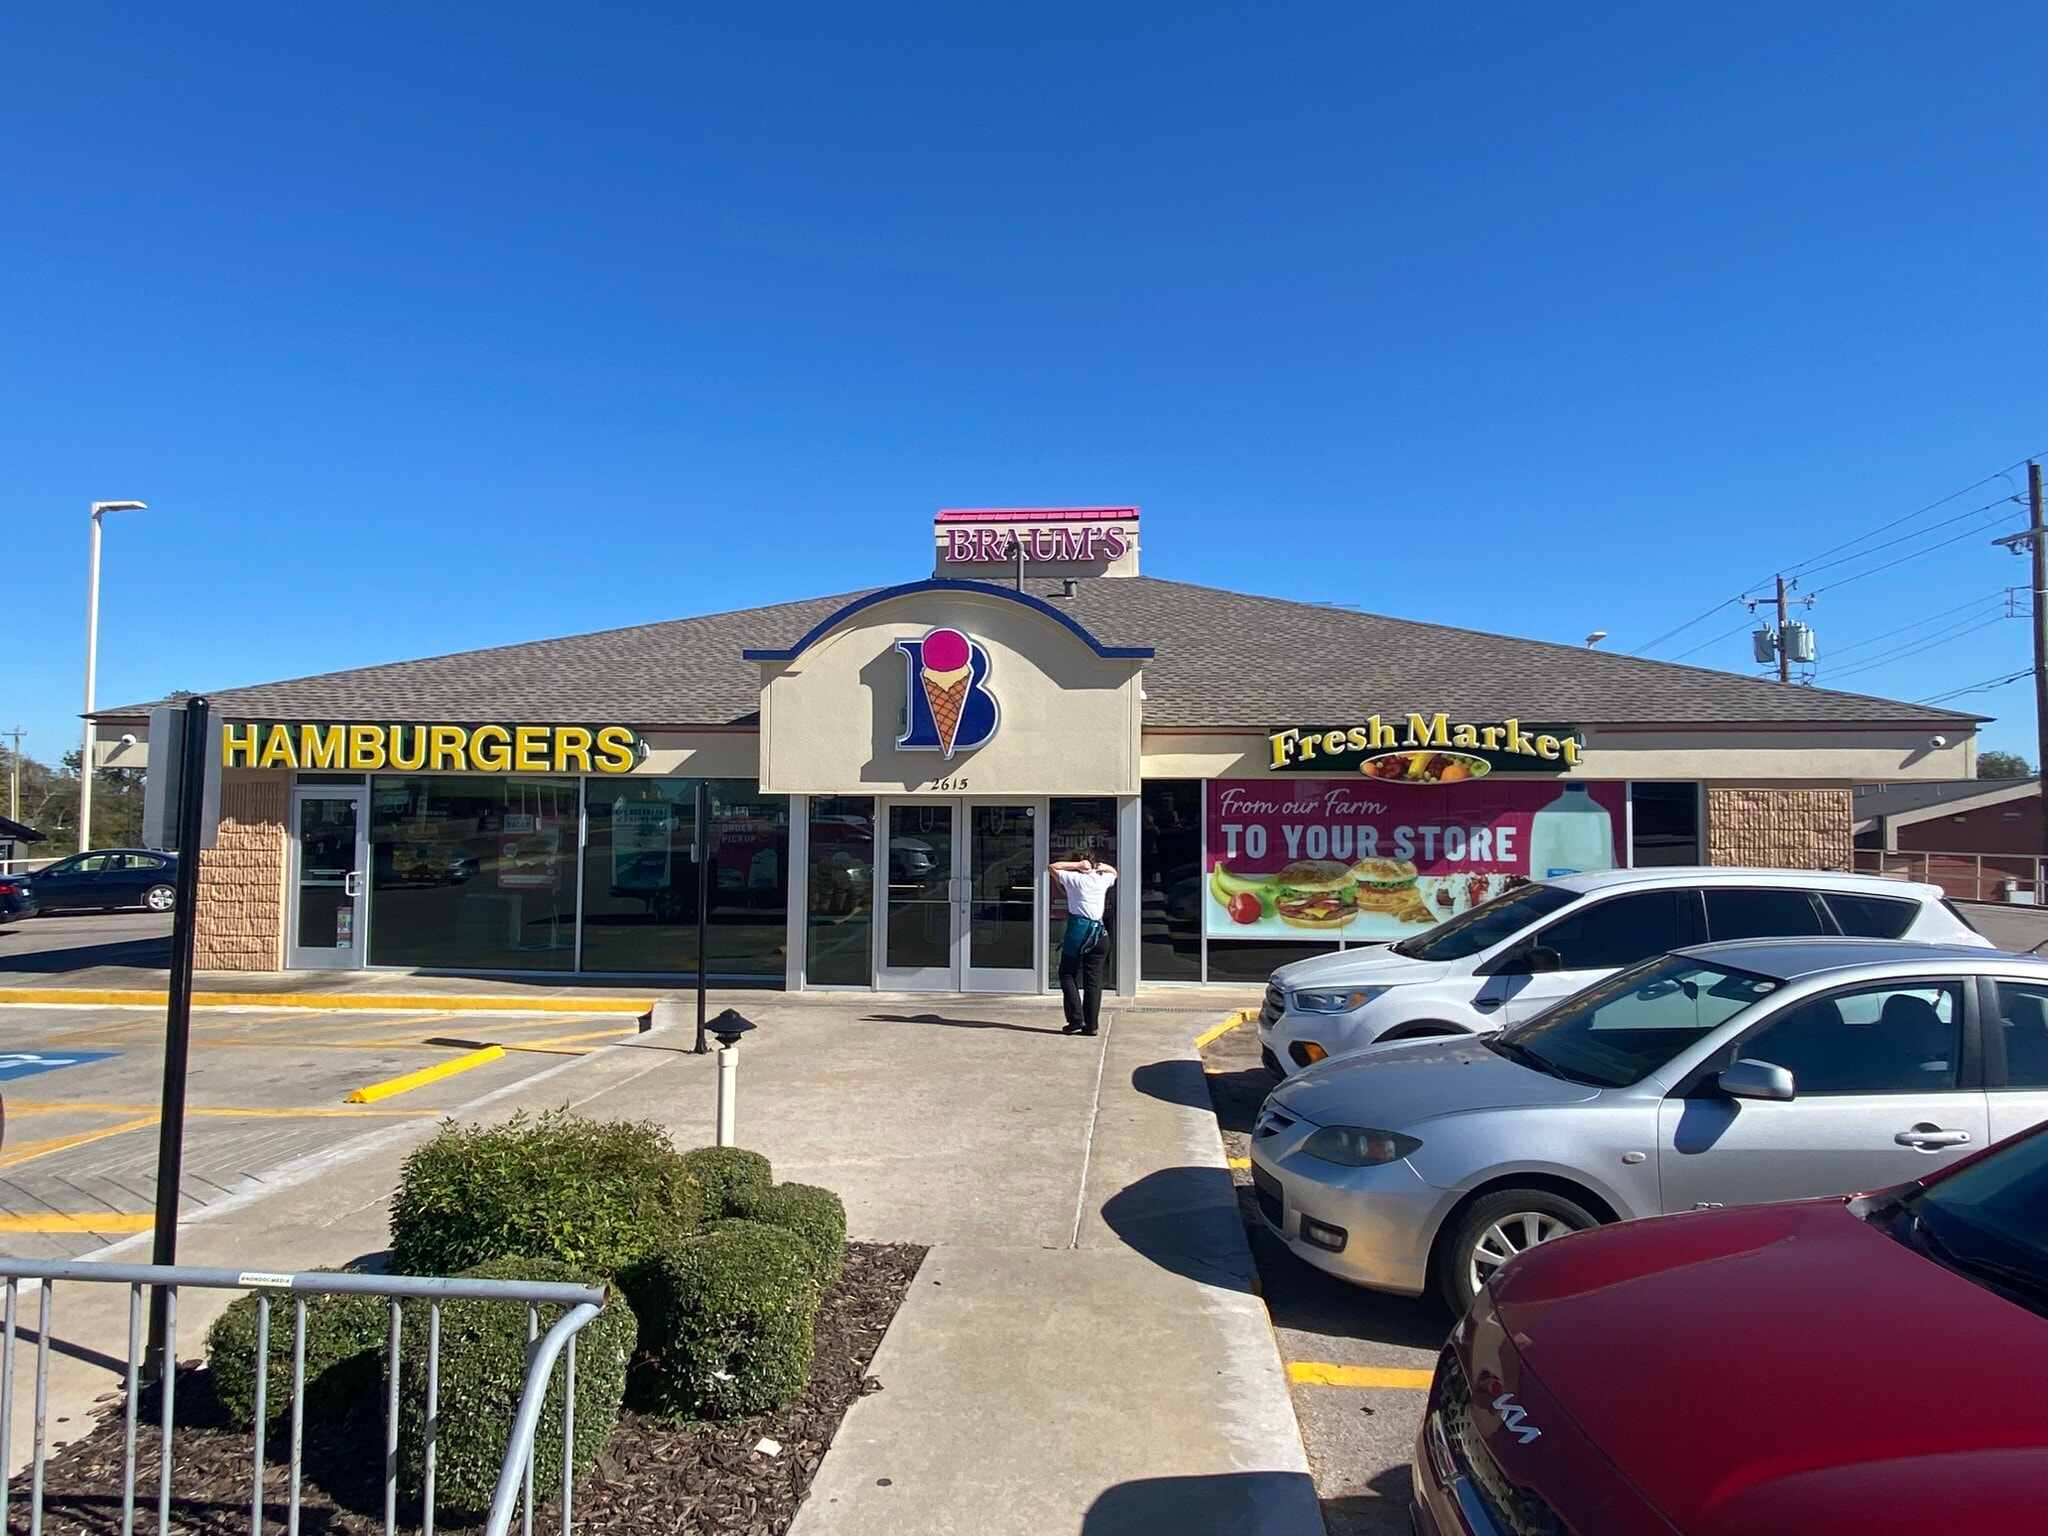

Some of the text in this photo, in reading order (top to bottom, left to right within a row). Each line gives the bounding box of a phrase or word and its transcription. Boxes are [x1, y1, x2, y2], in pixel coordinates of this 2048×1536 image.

[946, 527, 1127, 562] BRAUM'S
[222, 723, 637, 773] HAMBURGERS
[1268, 713, 1584, 769] Fresh Market
[931, 777, 969, 791] 2615
[1220, 788, 1388, 817] From our Farm
[722, 834, 757, 844] PICKUP
[1057, 835, 1105, 848] DINNER
[1221, 824, 1517, 862] TO YOUR STORE
